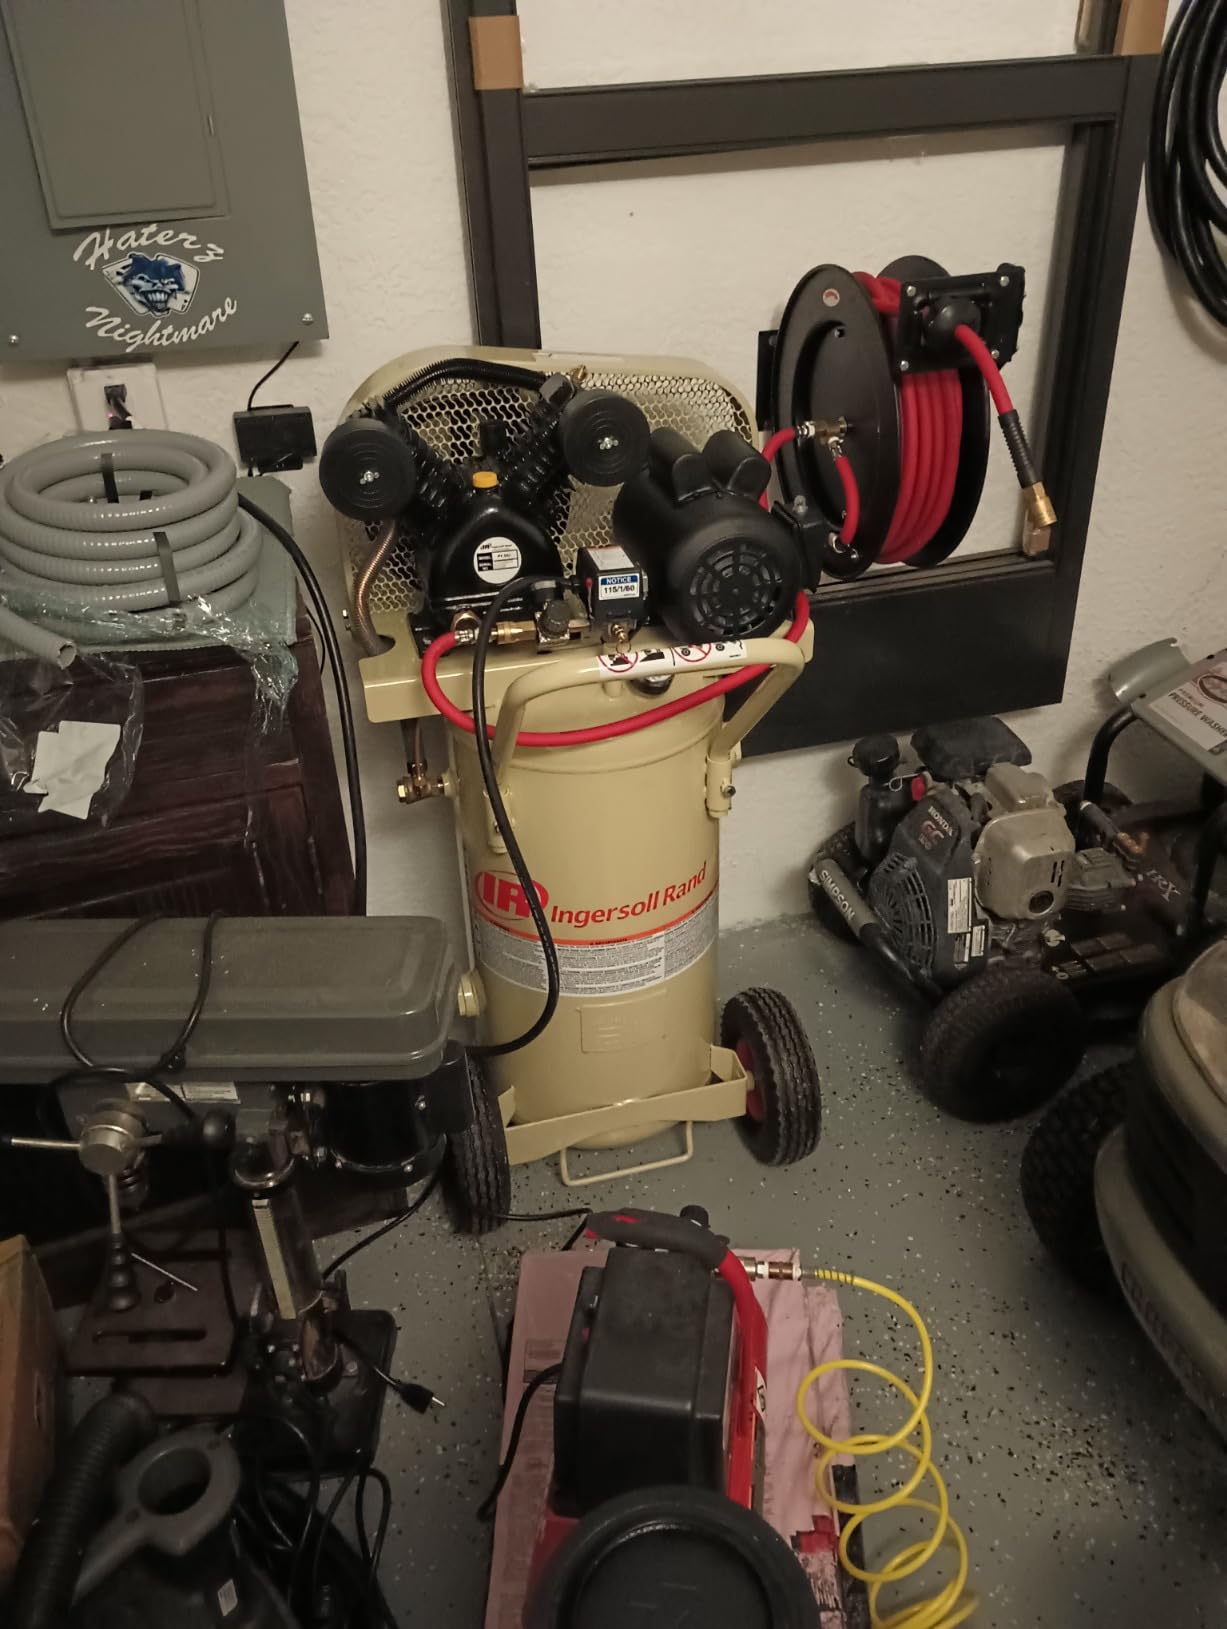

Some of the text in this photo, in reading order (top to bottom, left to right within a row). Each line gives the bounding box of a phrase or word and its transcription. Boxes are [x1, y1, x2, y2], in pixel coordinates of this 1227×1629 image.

[85, 297, 238, 353] Nightmare
[606, 576, 631, 585] NOTICE
[927, 805, 953, 837] HONDA
[550, 890, 660, 928] Ingersoll
[662, 860, 707, 907] Rand
[819, 870, 856, 921] SIMPSON
